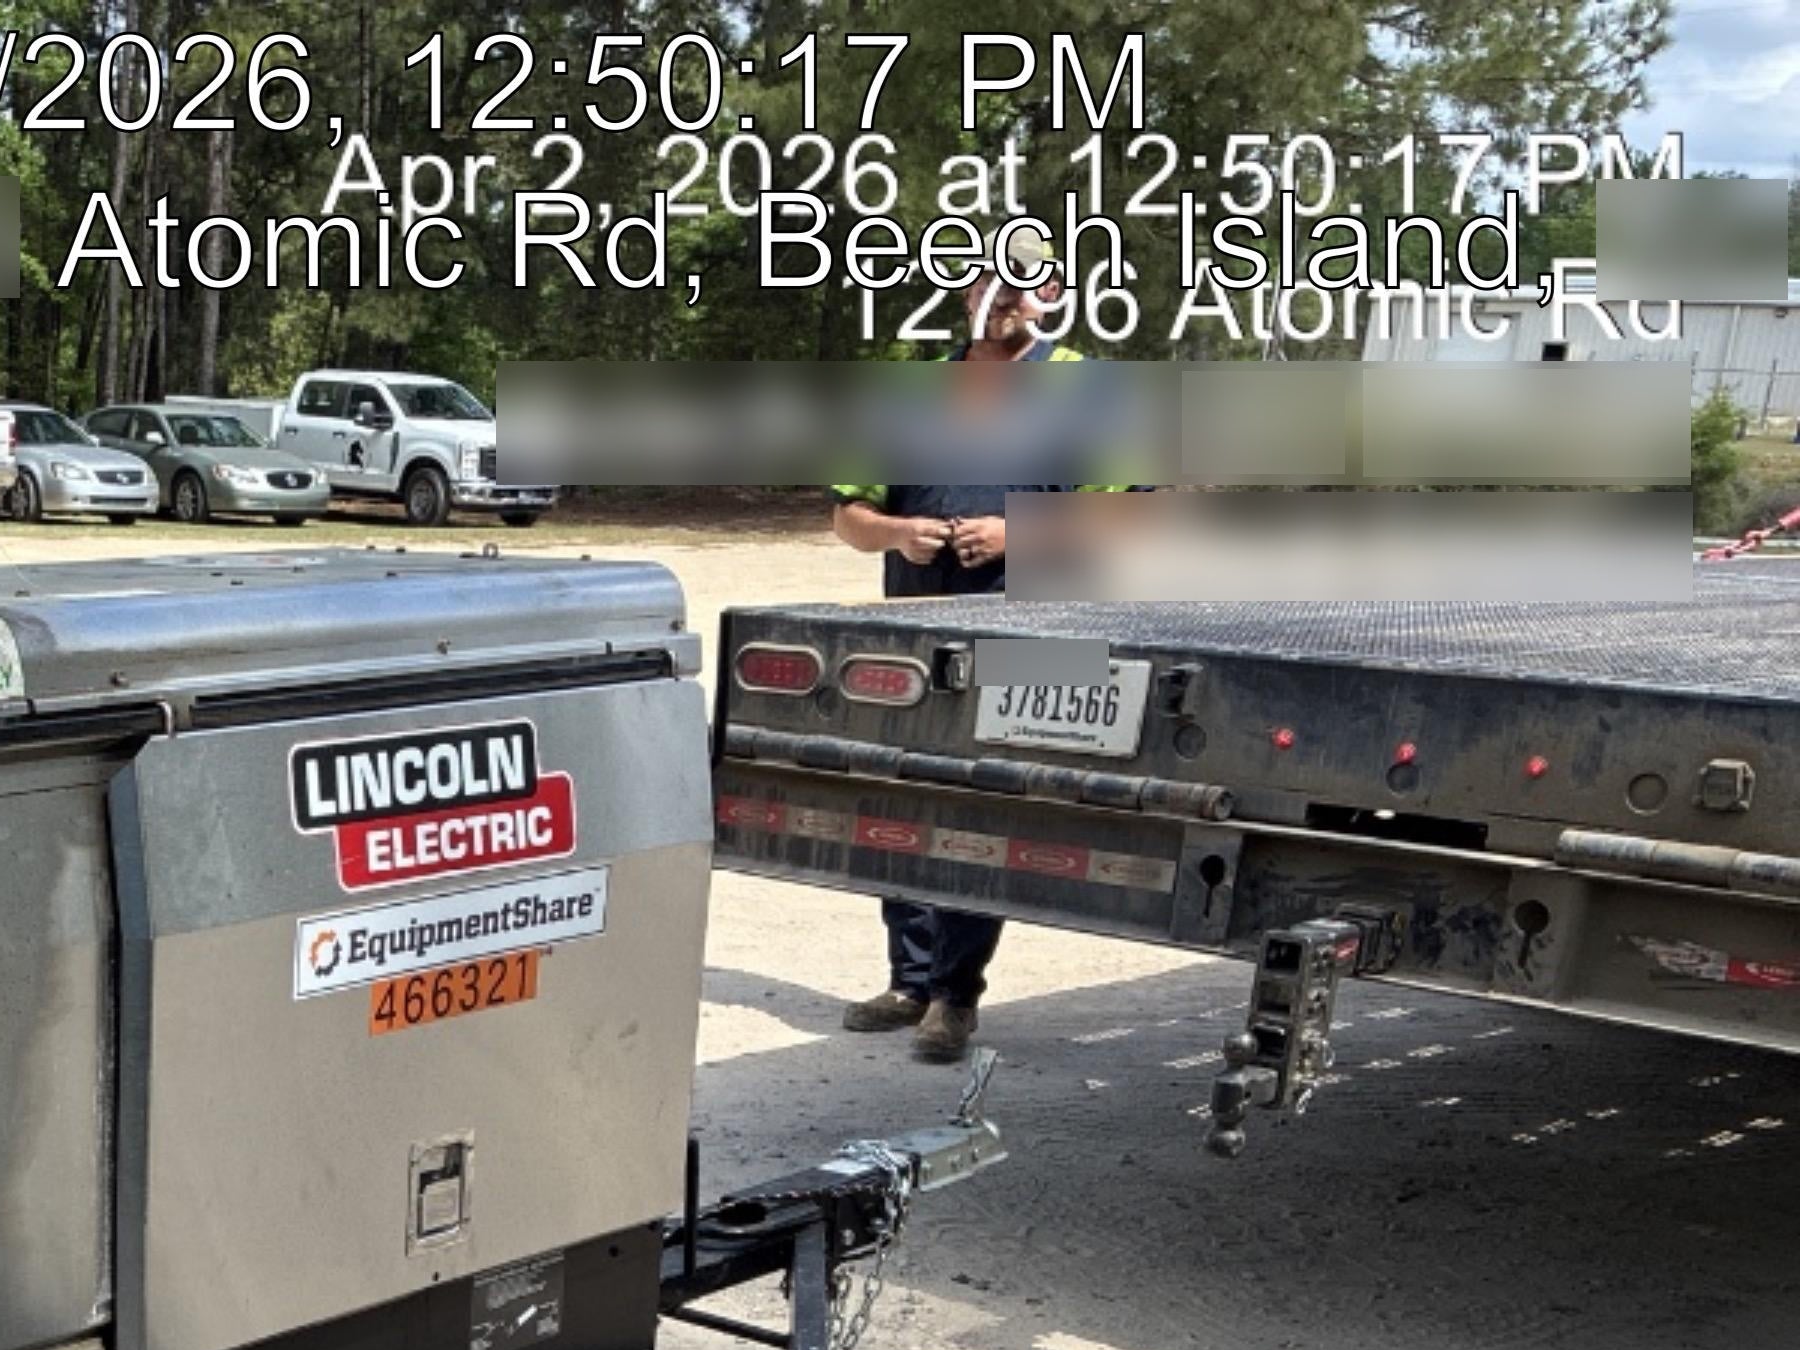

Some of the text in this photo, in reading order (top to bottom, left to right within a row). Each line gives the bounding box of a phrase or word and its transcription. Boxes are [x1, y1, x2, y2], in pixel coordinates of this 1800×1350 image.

[305, 735, 527, 818] LINCOLN
[365, 806, 553, 873] ELECTRIC
[347, 891, 594, 966] EquipmentShare
[374, 954, 528, 1029] 466321
